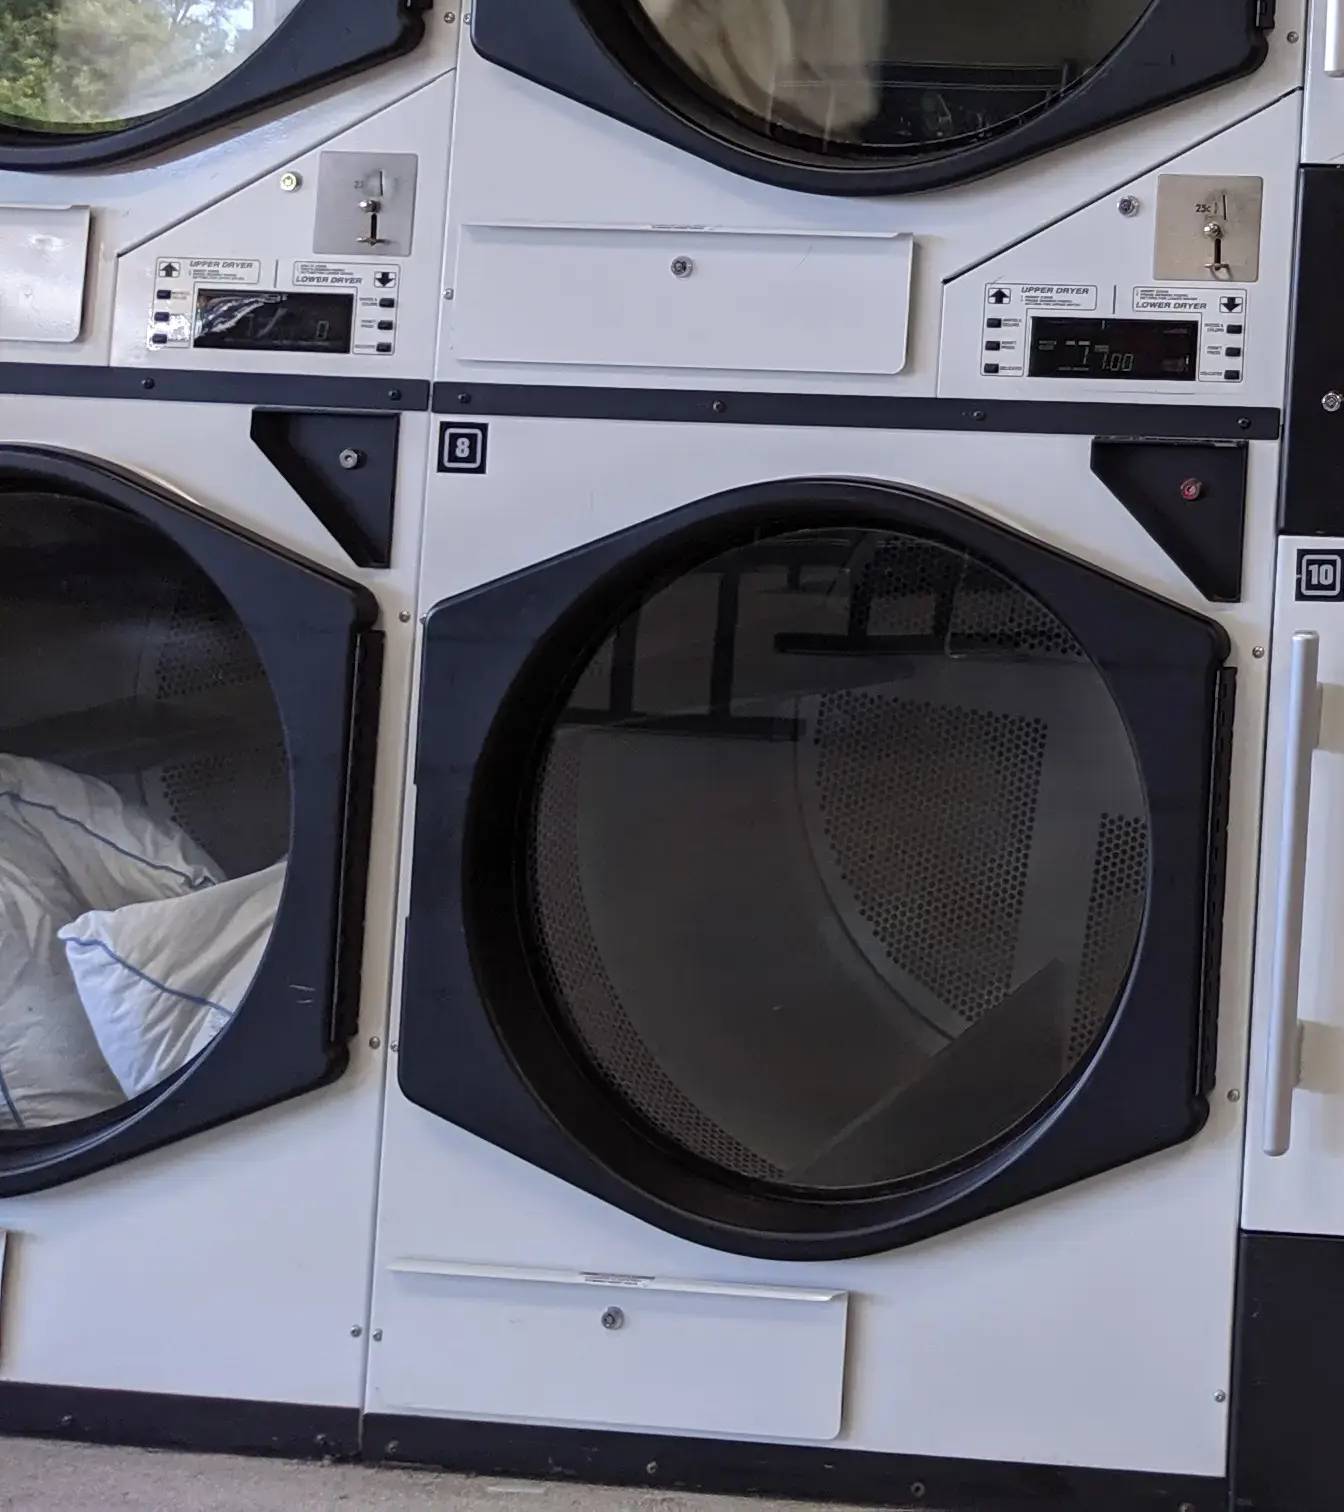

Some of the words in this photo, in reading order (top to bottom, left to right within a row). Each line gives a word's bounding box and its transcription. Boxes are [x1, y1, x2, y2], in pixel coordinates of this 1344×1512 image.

[189, 260, 220, 268] UPPER
[222, 261, 253, 269] DRYER
[296, 275, 328, 283] LOWER
[330, 276, 362, 284] DRYER
[1021, 286, 1054, 294] UPPER
[1056, 287, 1089, 295] DRYER
[1136, 301, 1171, 309] LOWER
[456, 437, 470, 458] 8
[1308, 564, 1334, 585] 10
